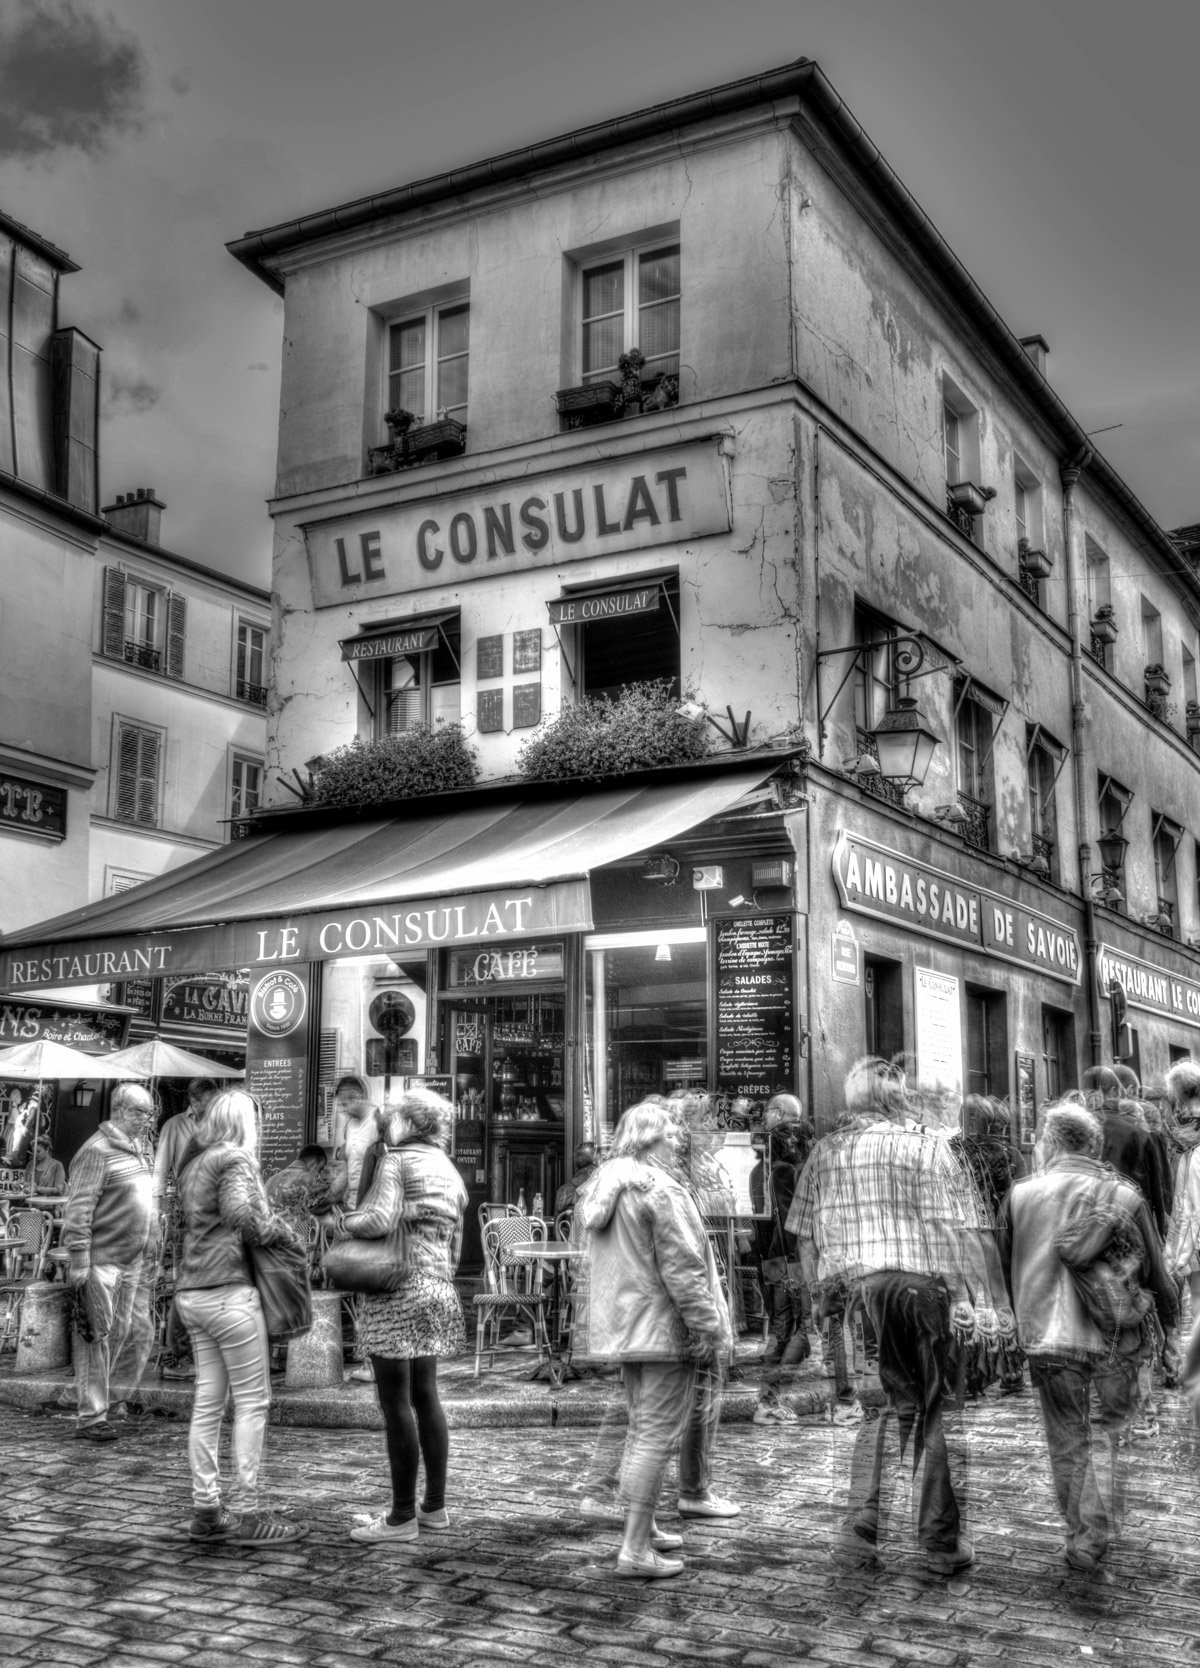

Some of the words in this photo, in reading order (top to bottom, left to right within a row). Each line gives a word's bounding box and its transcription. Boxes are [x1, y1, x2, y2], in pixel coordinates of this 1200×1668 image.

[335, 530, 386, 587] LE
[416, 466, 687, 573] CONSULAT
[559, 603, 576, 622] LE
[581, 591, 650, 619] CONSULAT
[352, 632, 425, 658] RESTAURANT
[846, 851, 978, 934] AMBASSADE
[993, 908, 1014, 947] DE
[1027, 921, 1077, 971] SAVOIE
[256, 927, 300, 961] LE
[319, 897, 532, 953] CONSULAT
[11, 945, 172, 984] RESTAURANT
[473, 946, 538, 981] CAFÉ
[735, 975, 772, 985] SALADES
[1102, 957, 1167, 1005] RESTAURANT
[1172, 983, 1183, 1010] LE
[184, 987, 199, 1004] LA
[183, 1007, 196, 1019] LA
[198, 1009, 223, 1022] BONNE
[224, 1012, 248, 1025] FRAN
[42, 1028, 61, 1041] Boire
[63, 1031, 72, 1041] et
[737, 1084, 770, 1094] CRÊPES
[265, 1112, 285, 1120] PLATS
